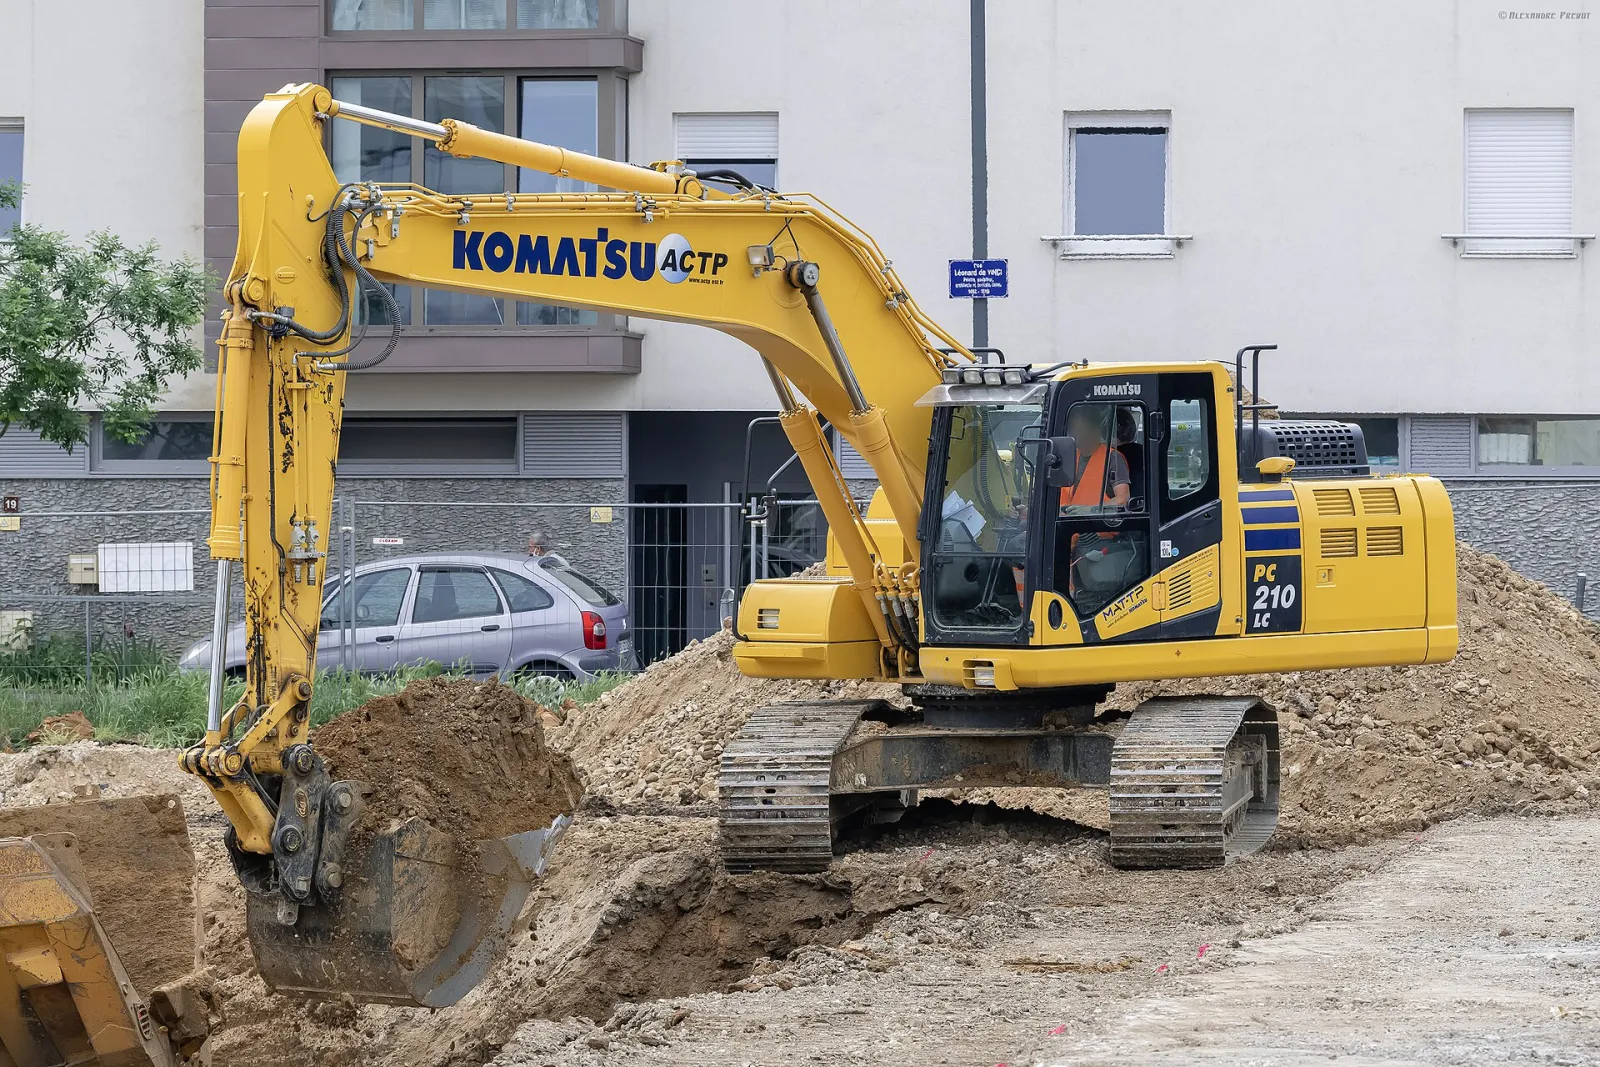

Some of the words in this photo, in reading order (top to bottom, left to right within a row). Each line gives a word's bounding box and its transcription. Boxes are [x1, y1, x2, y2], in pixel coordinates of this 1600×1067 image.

[453, 227, 656, 281] KOMATSU
[660, 249, 728, 276] ACTP
[1093, 382, 1141, 396] KOMATSU
[5, 499, 17, 509] 19
[1253, 563, 1277, 582] PC
[1102, 585, 1144, 622] MAT-TP
[1253, 584, 1296, 610] 210
[1253, 612, 1271, 628] LC
